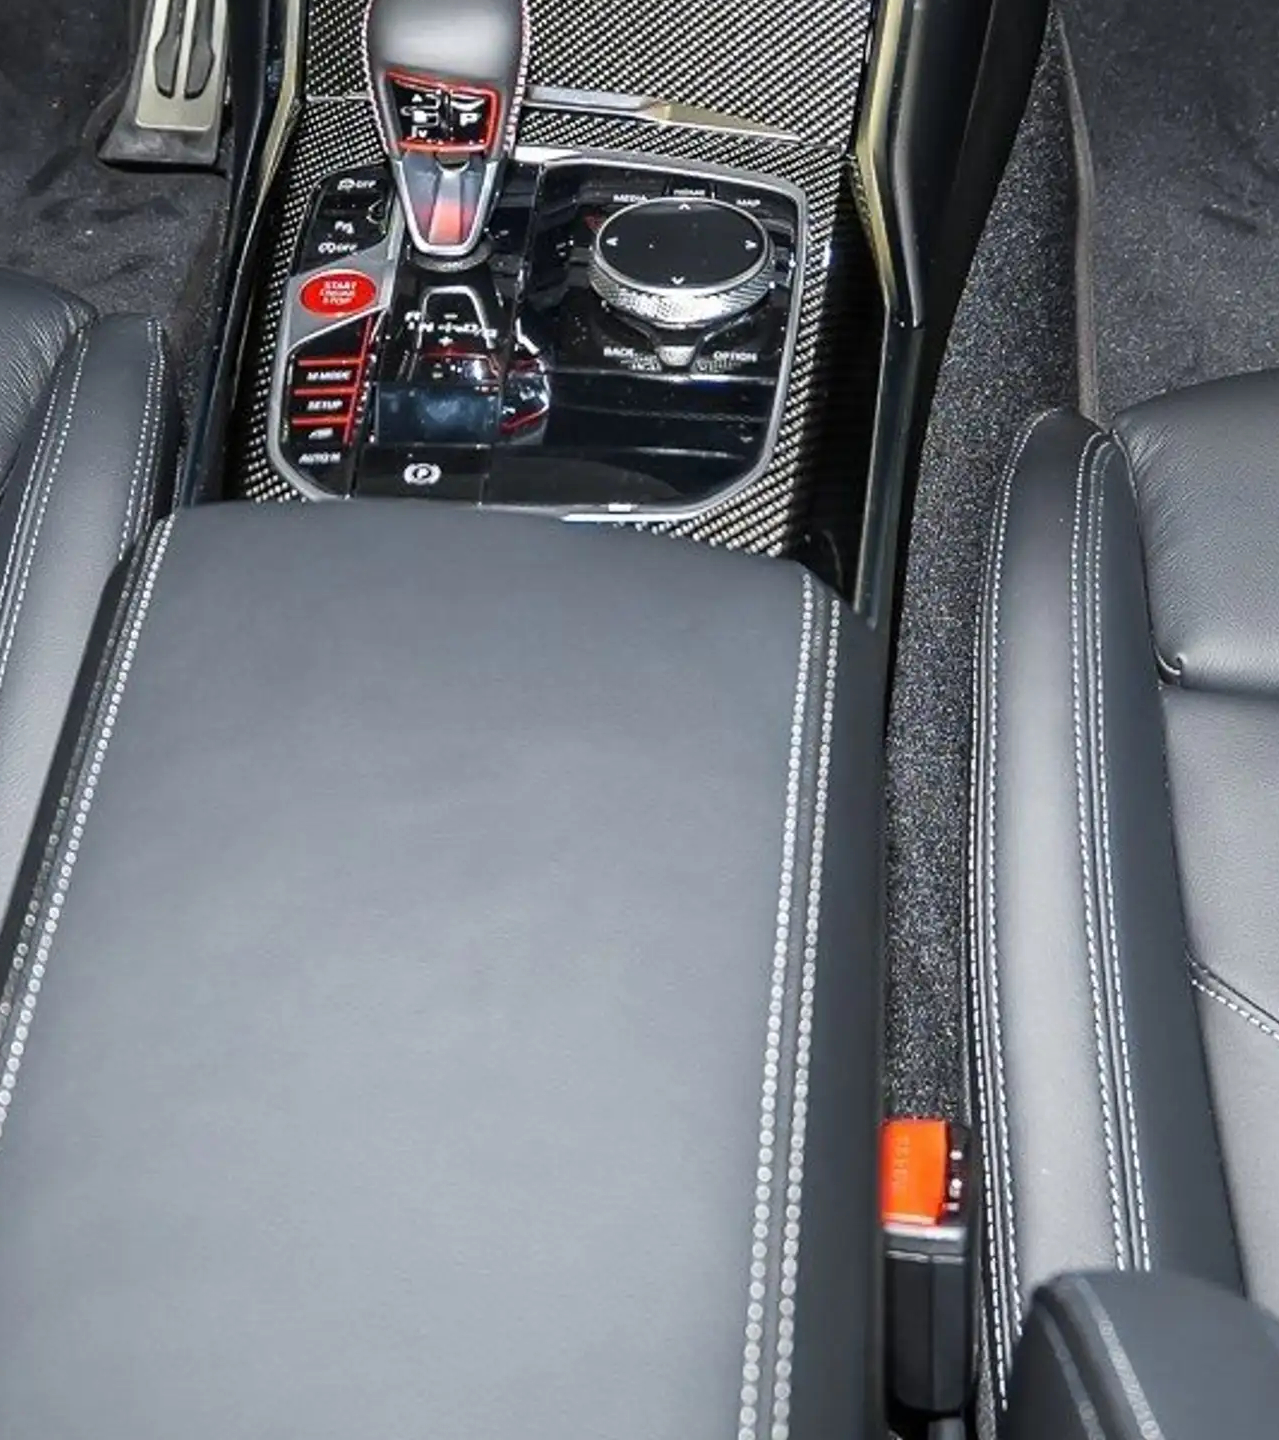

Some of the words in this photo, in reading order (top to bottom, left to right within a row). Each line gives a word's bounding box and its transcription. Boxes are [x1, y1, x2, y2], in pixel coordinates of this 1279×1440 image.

[613, 193, 648, 203] MEDIA
[736, 198, 761, 207] MAP
[324, 280, 357, 290] START
[603, 346, 635, 358] BACK
[712, 350, 759, 363] OPTION
[307, 400, 343, 411] SETUP
[298, 453, 329, 464] AUTO
